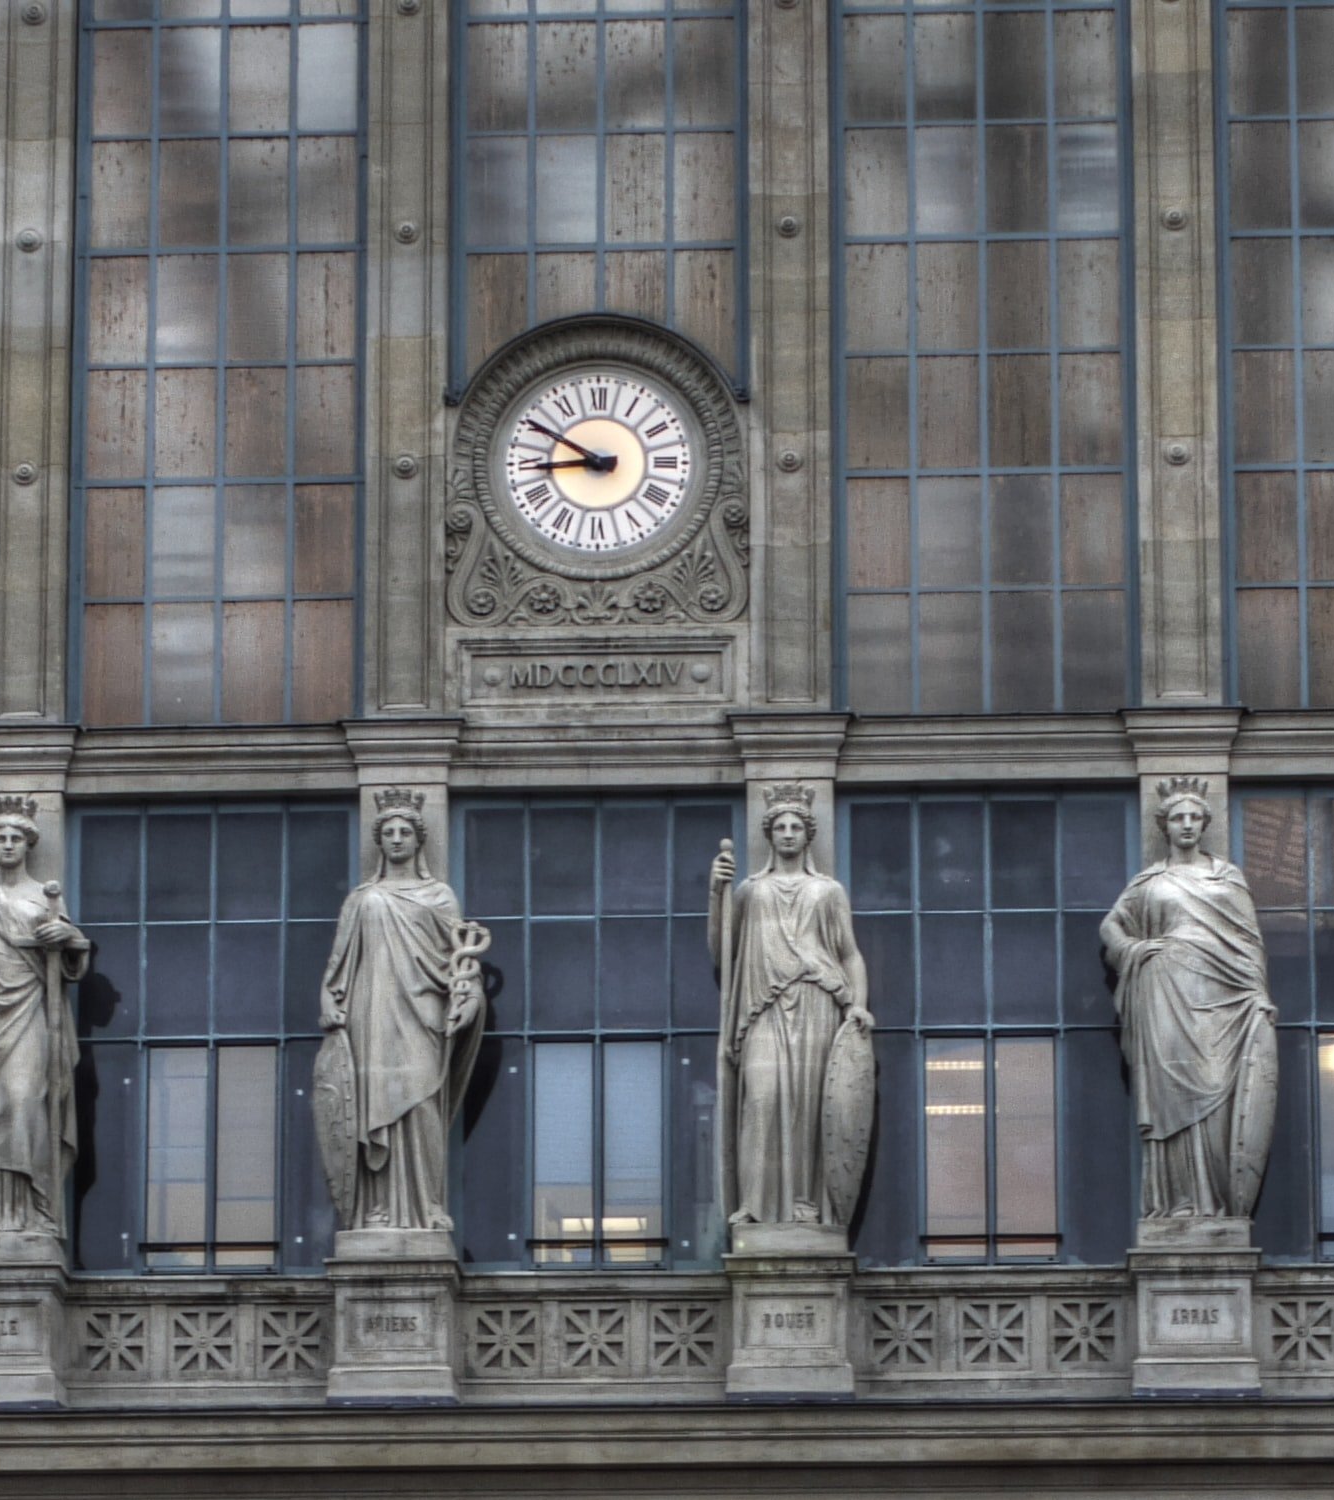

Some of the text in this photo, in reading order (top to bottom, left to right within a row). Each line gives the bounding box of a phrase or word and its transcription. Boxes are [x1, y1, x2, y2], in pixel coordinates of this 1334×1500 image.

[553, 394, 577, 418] XI
[589, 386, 608, 413] XII
[644, 420, 670, 439] II
[653, 456, 678, 470] III
[509, 661, 685, 688] MDCCCLXIV
[1171, 1308, 1220, 1325] ARRAS
